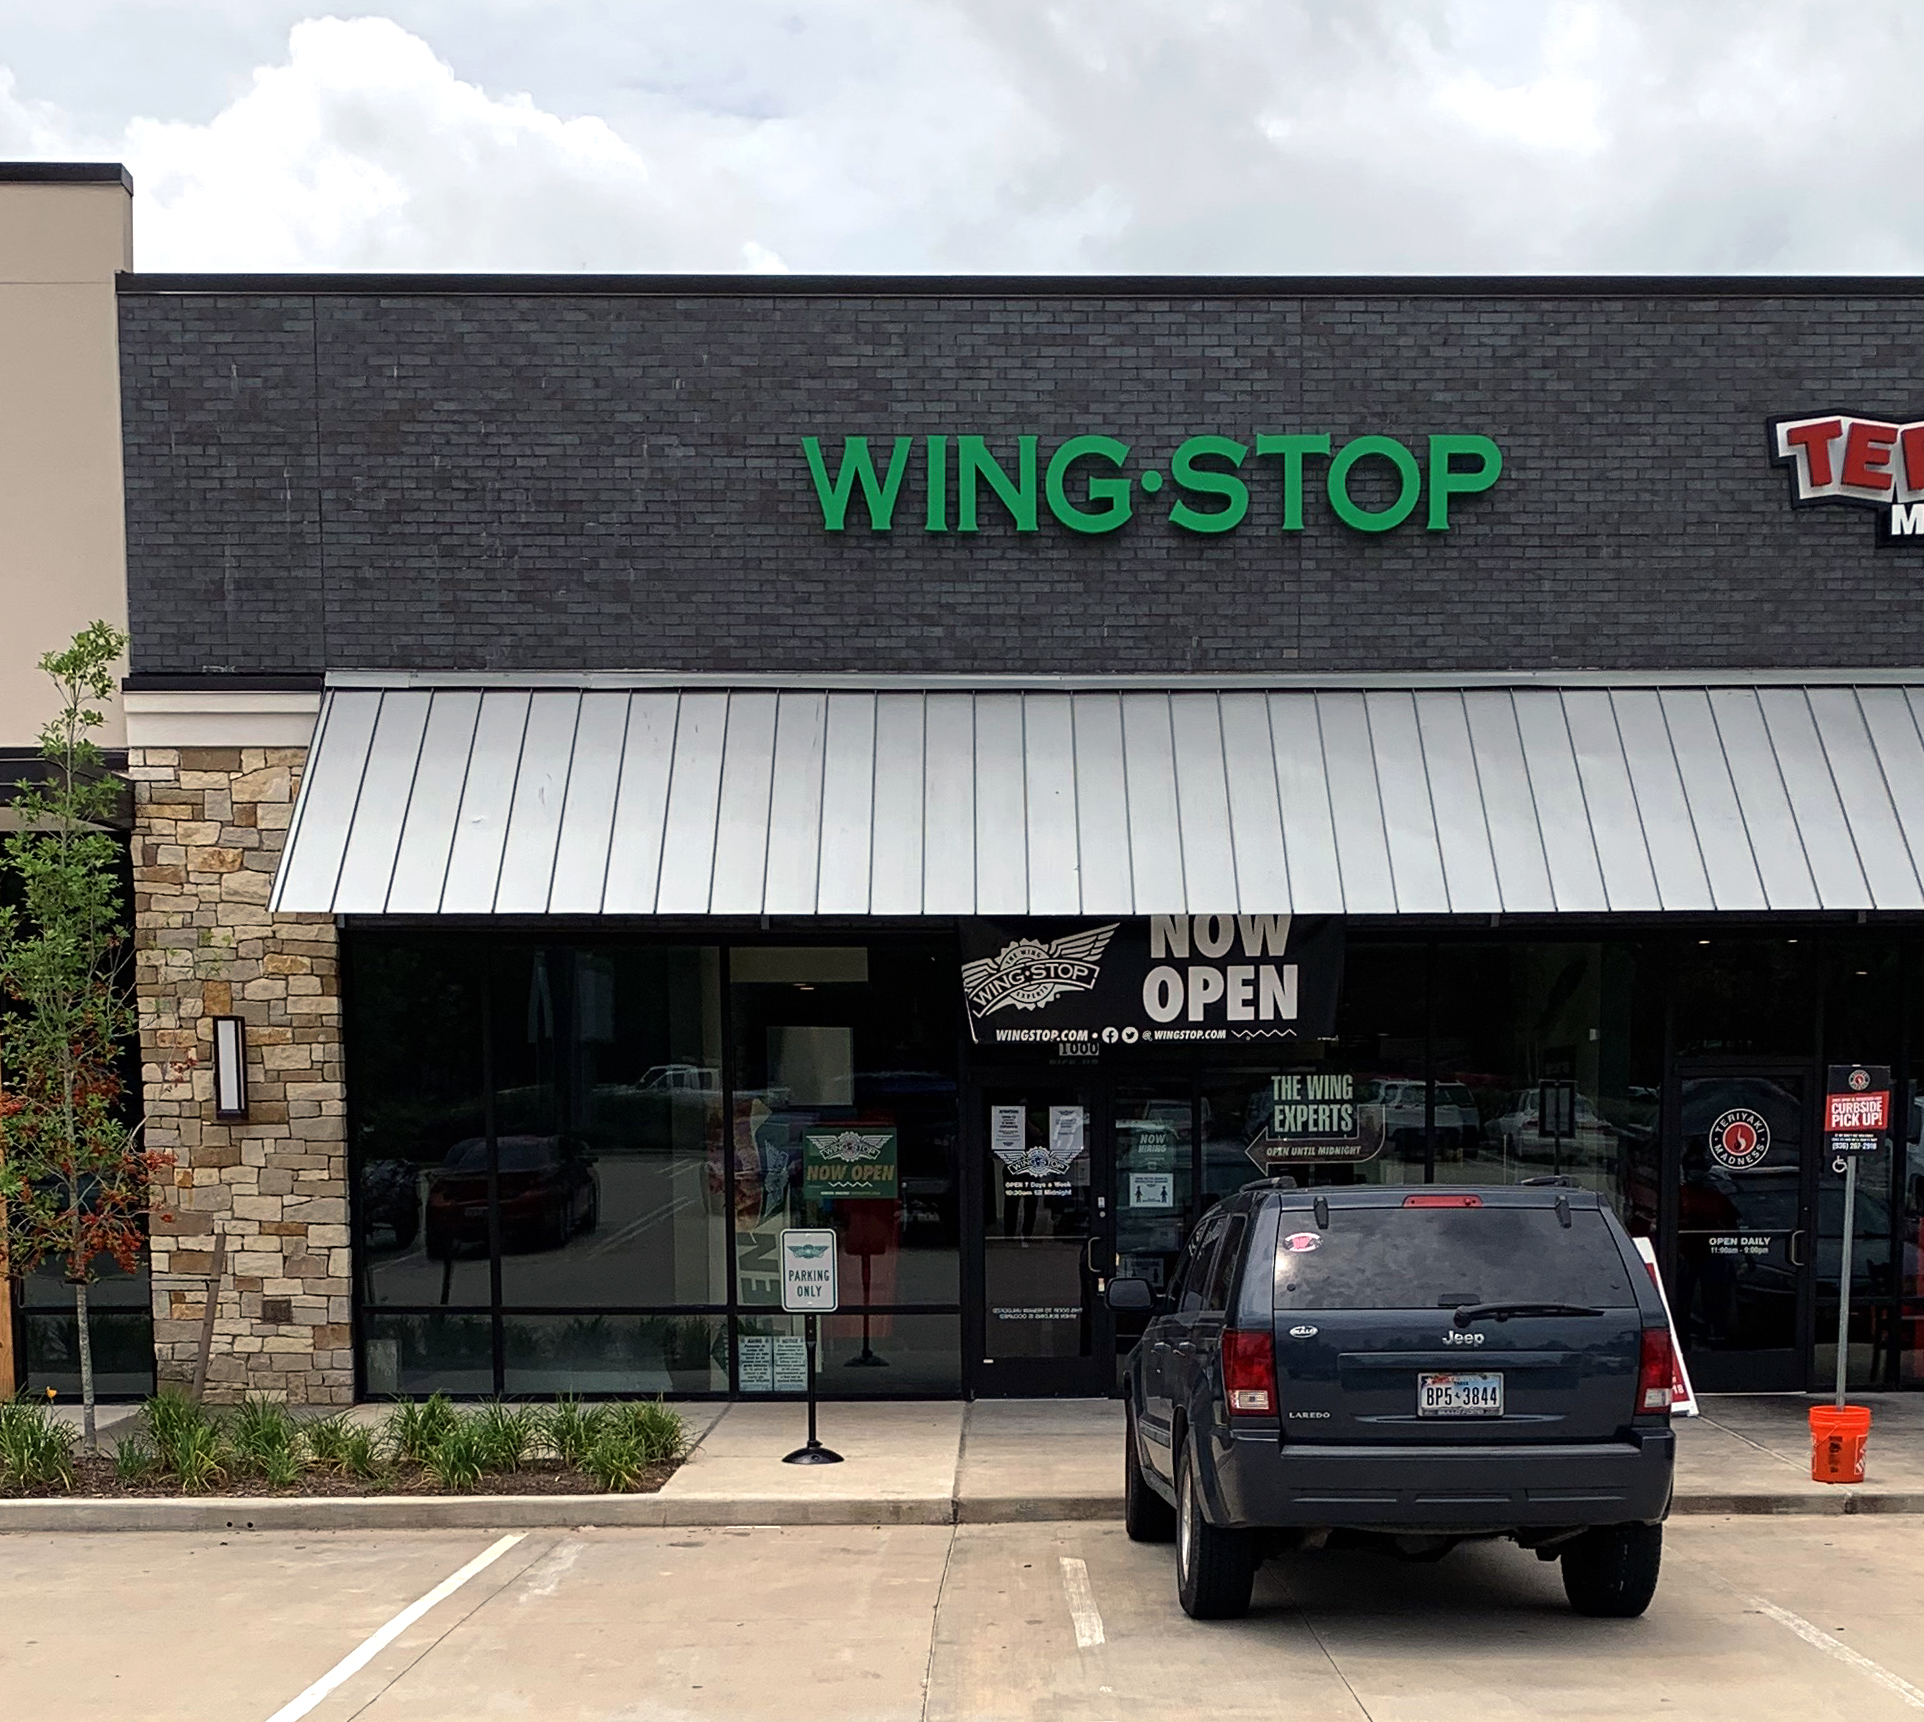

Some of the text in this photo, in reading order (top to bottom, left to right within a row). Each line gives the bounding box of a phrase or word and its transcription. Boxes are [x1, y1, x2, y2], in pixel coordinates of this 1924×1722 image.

[1150, 915, 1292, 959] NOW
[1142, 964, 1299, 1023] OPEN
[995, 1029, 1089, 1042] WINGSTOP.COM
[1153, 1029, 1227, 1040] WINGSTOP.COM
[1061, 1042, 1098, 1055] 1000
[1271, 1074, 1353, 1101] THE WING
[1831, 1101, 1883, 1115] CURBSIDE
[1274, 1103, 1353, 1133] EXPERTS
[1714, 1112, 1765, 1134] TERIYAKI
[1831, 1111, 1883, 1128] PICK UP!
[1139, 1133, 1166, 1144] NOW
[1266, 1145, 1362, 1157] OPEN UNTIL MIDNIGHT
[1713, 1143, 1765, 1165] MADNESS
[806, 1164, 895, 1181] NOW OPEN
[1708, 1236, 1772, 1246] OPEN DAILY
[1710, 1246, 1739, 1254] 11:00am
[788, 1269, 830, 1282] PARKING
[796, 1285, 823, 1298] ONLY
[1441, 1330, 1485, 1347] Jeep
[1288, 1411, 1331, 1419] LAREDO
